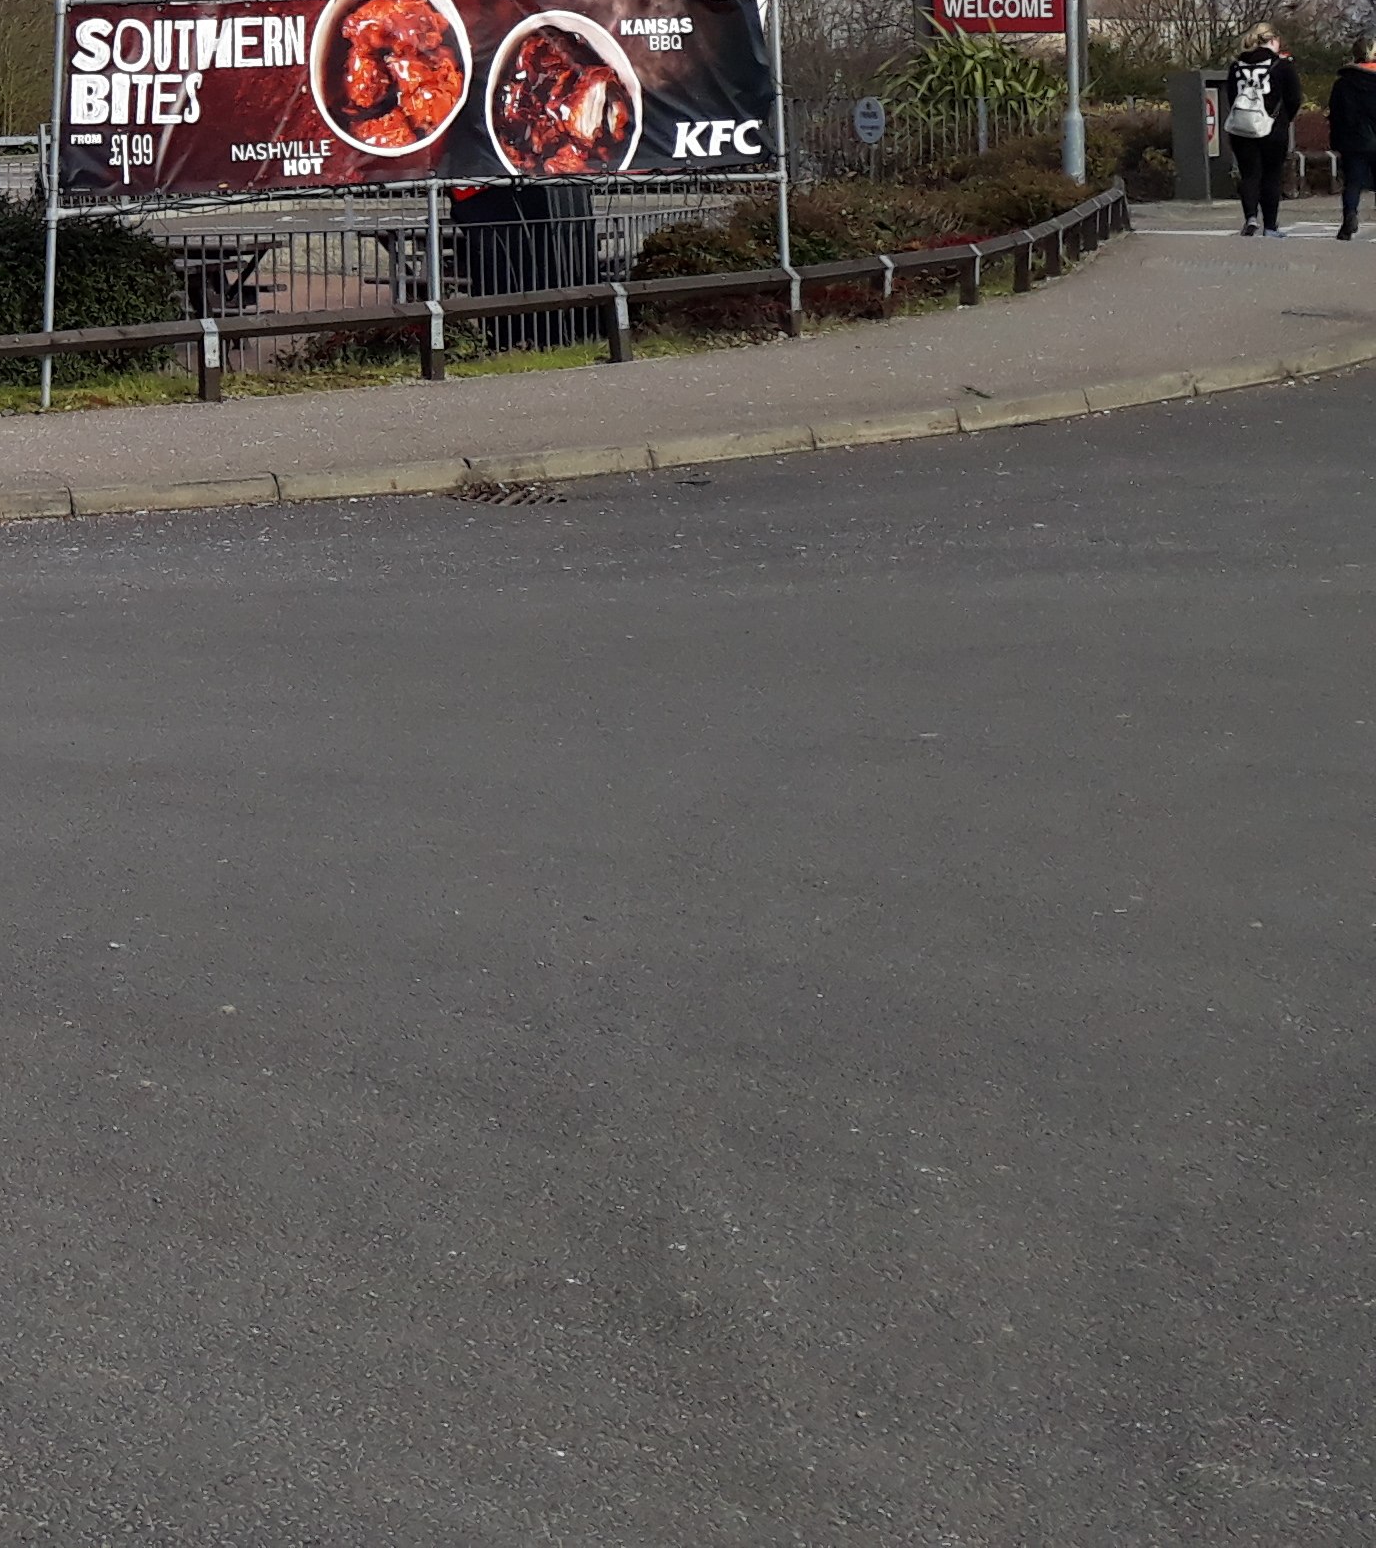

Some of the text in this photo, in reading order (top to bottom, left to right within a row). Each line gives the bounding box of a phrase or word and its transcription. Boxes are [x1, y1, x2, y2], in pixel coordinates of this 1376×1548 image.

[620, 17, 694, 36] KANSAS
[71, 15, 306, 72] SOUTHERN
[650, 35, 683, 51] BBQ
[70, 72, 203, 125] BITES
[231, 138, 333, 162] NASHVILLE
[672, 119, 763, 159] KFC
[70, 133, 153, 184] FROM £1.99
[283, 157, 324, 177] HOT
